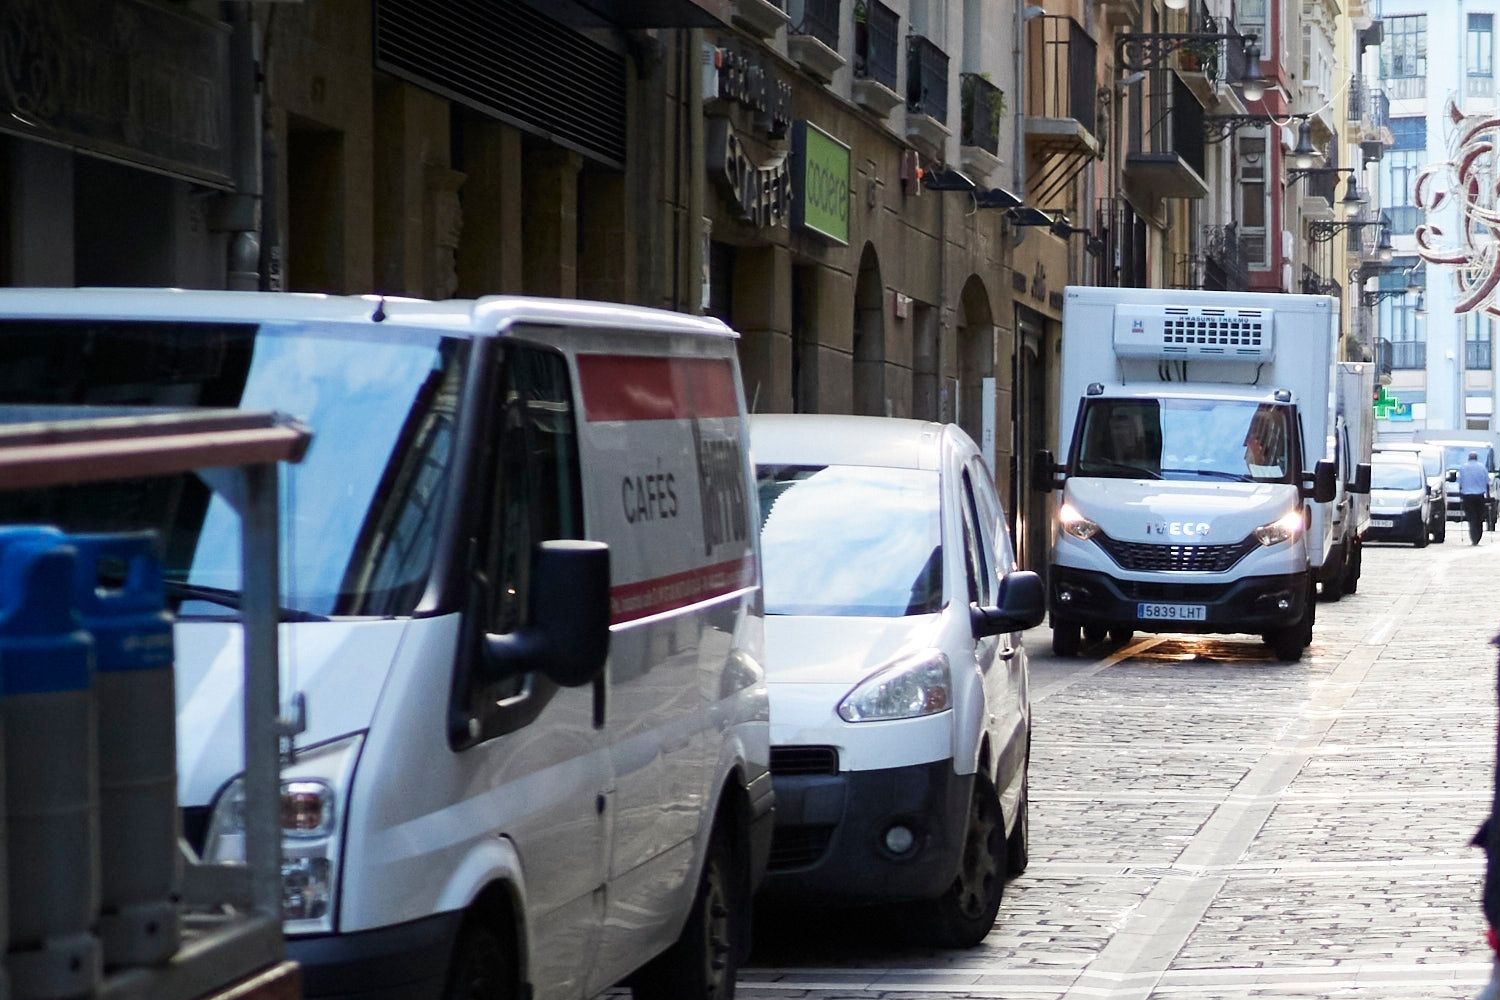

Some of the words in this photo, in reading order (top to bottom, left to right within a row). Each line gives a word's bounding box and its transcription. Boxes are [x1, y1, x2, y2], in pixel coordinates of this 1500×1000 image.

[622, 457, 679, 525] CAFÉS
[1146, 522, 1211, 536] IVECO
[1146, 605, 1176, 617] 5839
[1180, 607, 1203, 619] LHT
